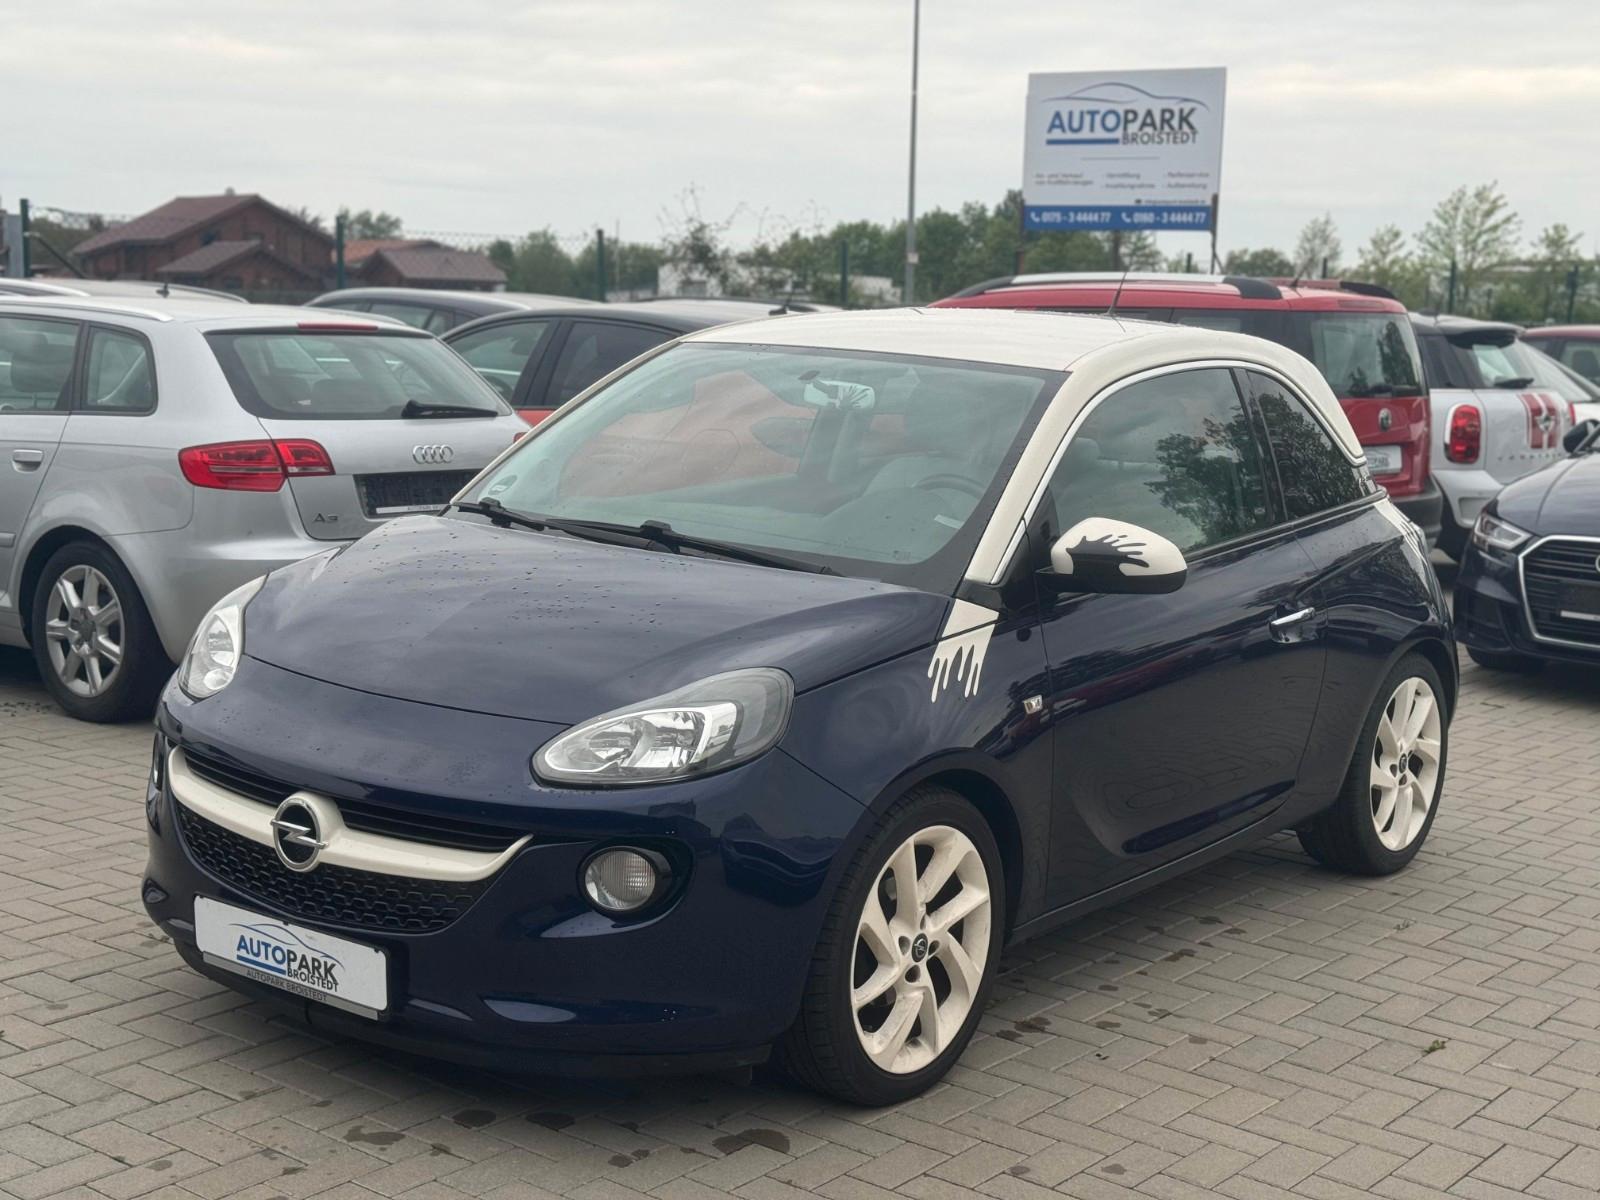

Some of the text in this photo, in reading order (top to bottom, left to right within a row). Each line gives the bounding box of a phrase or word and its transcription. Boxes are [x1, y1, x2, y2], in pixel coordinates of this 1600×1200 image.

[1047, 108, 1197, 133] AUTOPARK
[1122, 131, 1198, 145] BROISTEDT
[236, 934, 337, 982] AUTOPARK
[247, 969, 328, 1001] AUTOPARK BROISTEDT
[287, 968, 338, 992] BROISTEDT
